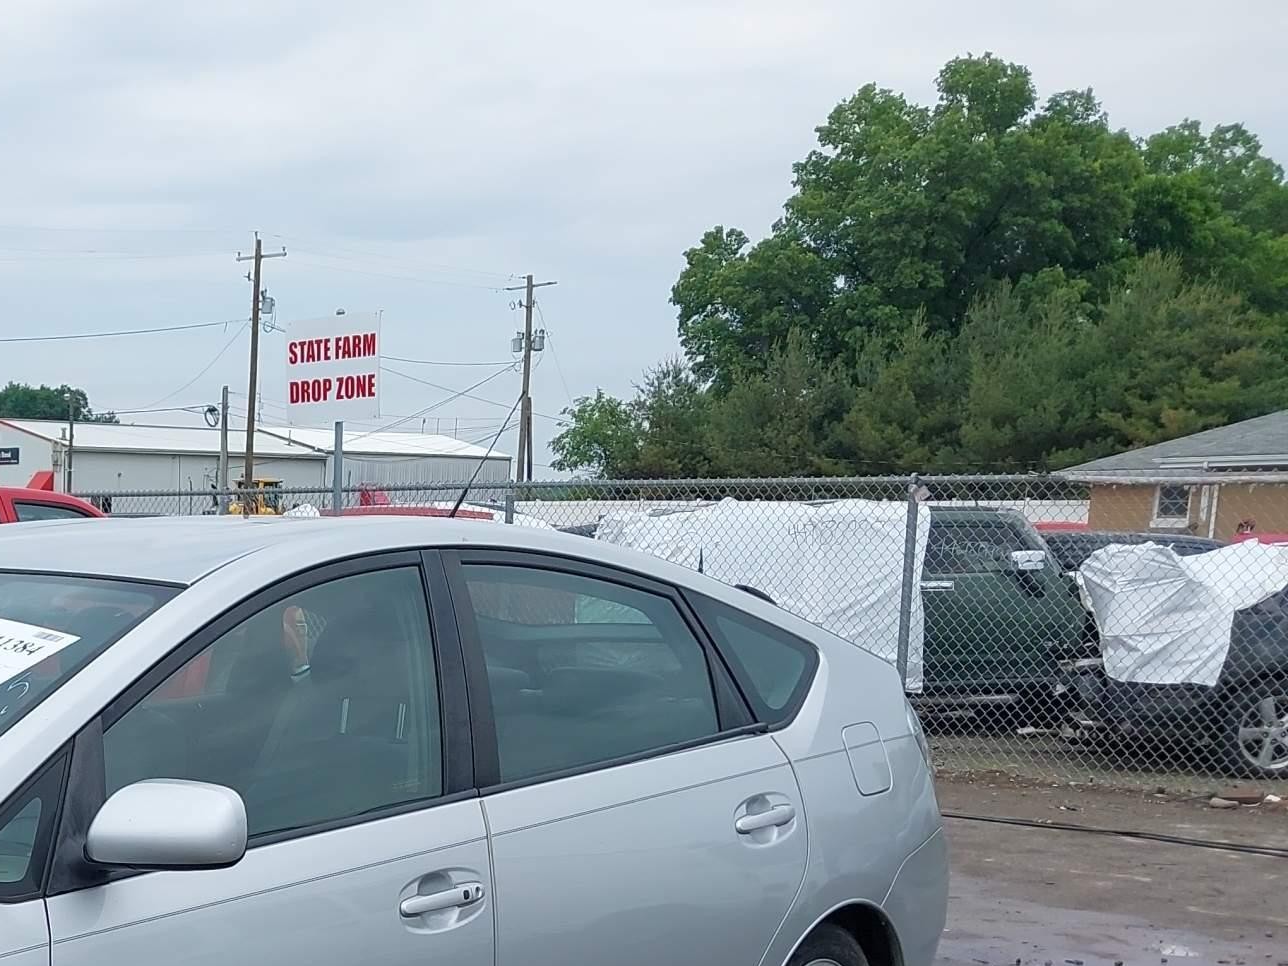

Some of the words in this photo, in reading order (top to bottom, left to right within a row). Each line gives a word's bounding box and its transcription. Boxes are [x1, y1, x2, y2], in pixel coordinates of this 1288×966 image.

[288, 335, 332, 366] STATE
[334, 332, 377, 362] FARM
[288, 377, 333, 405] DROP
[335, 373, 377, 402] ZONE
